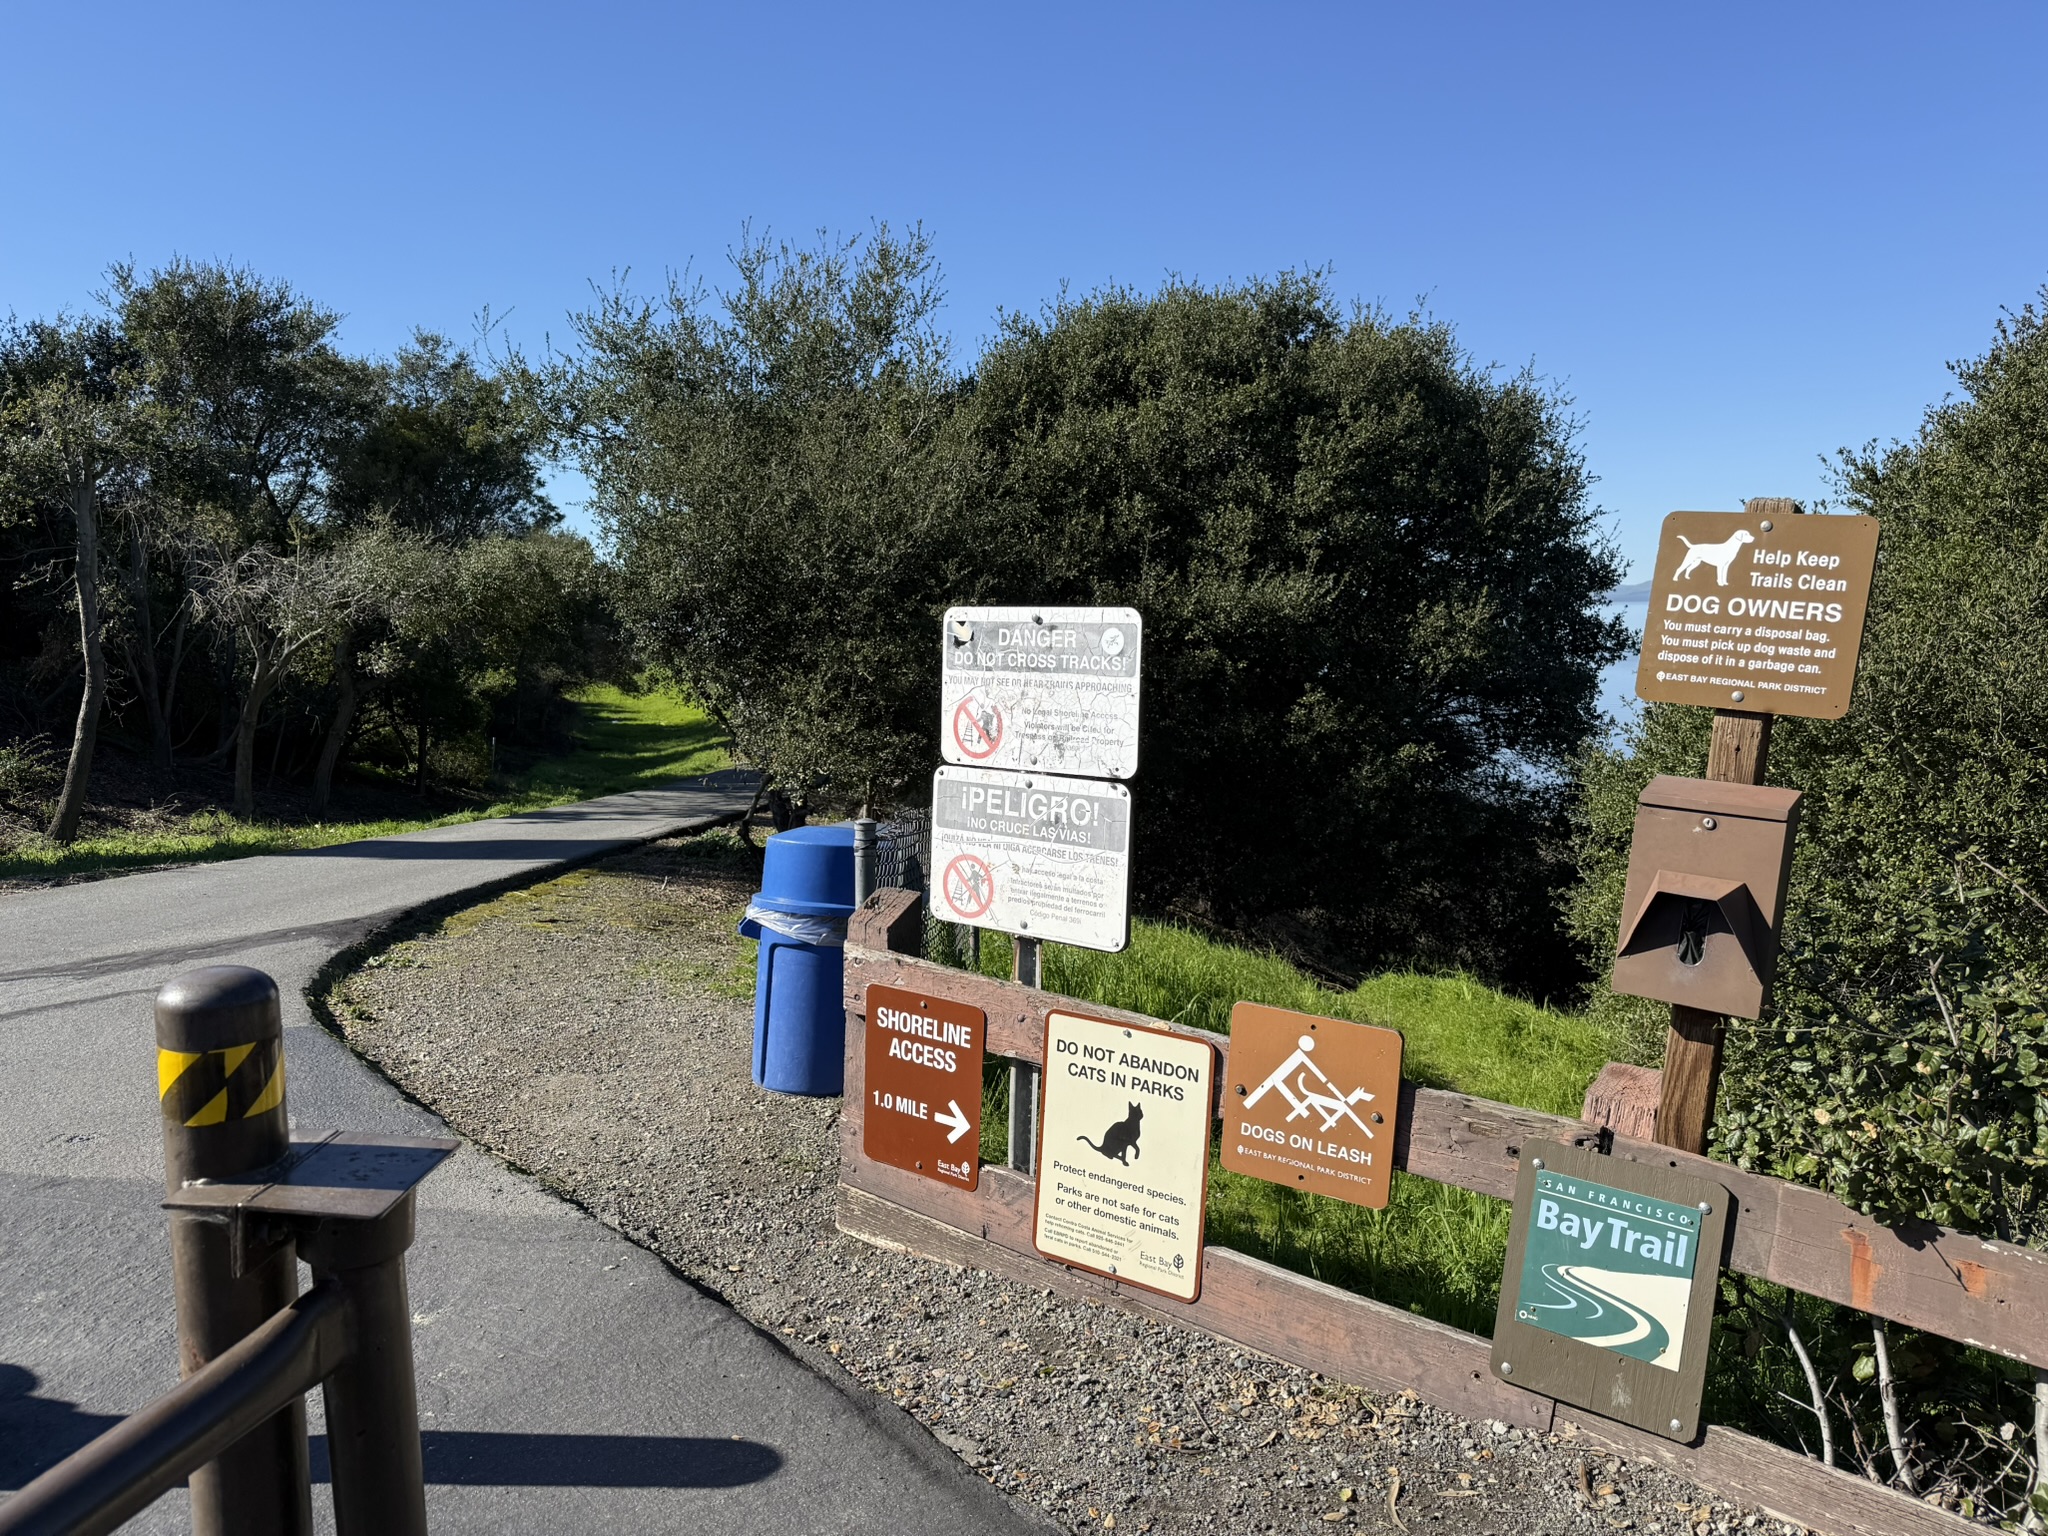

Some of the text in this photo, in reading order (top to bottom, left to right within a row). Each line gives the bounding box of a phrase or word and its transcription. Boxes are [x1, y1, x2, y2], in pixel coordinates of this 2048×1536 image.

[1753, 549, 1839, 569] Help Keep
[1750, 572, 1846, 591] Trails Clean
[1666, 594, 1842, 623] DOG OWNERS
[998, 629, 1076, 647] DANGER
[1664, 619, 1830, 643] You must carry a disposal bag.
[1661, 635, 1836, 659] You must pick up dog waste and
[955, 652, 1126, 670] DO NOT CROSS TRACKS!
[1658, 651, 1821, 674] dispose of it in a garbage can.
[949, 676, 962, 684] YOU
[964, 677, 978, 685] MAY
[981, 677, 995, 686] NOT
[997, 678, 1009, 686] SEE
[1024, 679, 1043, 688] HEAR
[1075, 682, 1132, 692] APPROACHING
[1666, 673, 1827, 694] EAST BAY REGIONAL PARK DISTRICT
[961, 786, 1098, 827] ¡PELIGRO!
[990, 821, 1030, 835] CRUCE
[1033, 826, 1056, 838] LAS
[1059, 827, 1091, 844] VIAS!
[1003, 844, 1020, 852] OIGA
[1069, 851, 1083, 860] LOS
[1086, 877, 1103, 885] costa
[1071, 897, 1097, 907] terrenos
[1074, 907, 1105, 918] ferrocarril
[1030, 909, 1049, 919] Código
[1051, 914, 1067, 922] Penal
[877, 1007, 971, 1048] SHORELINE
[889, 1038, 956, 1072] ACCESS
[1056, 1039, 1199, 1082] DO NOT ABANDON
[1068, 1063, 1184, 1101] CATS IN PARKS
[873, 1090, 927, 1119] 1.0 MILE
[1241, 1123, 1372, 1166] DOGS ON LEASH
[938, 1160, 960, 1174] East Bay
[1245, 1148, 1372, 1185] EAST BAY REGIONAL PARK DISTRICT
[1054, 1161, 1187, 1206] Protect endangered species.
[1057, 1183, 1179, 1226] Parks are not safe for cats
[1545, 1180, 1688, 1224] SAN FRANCISCO
[1055, 1197, 1179, 1240] or other domestic animals.
[1537, 1199, 1688, 1267] Bay Trail
[1140, 1251, 1172, 1270] East Bay
